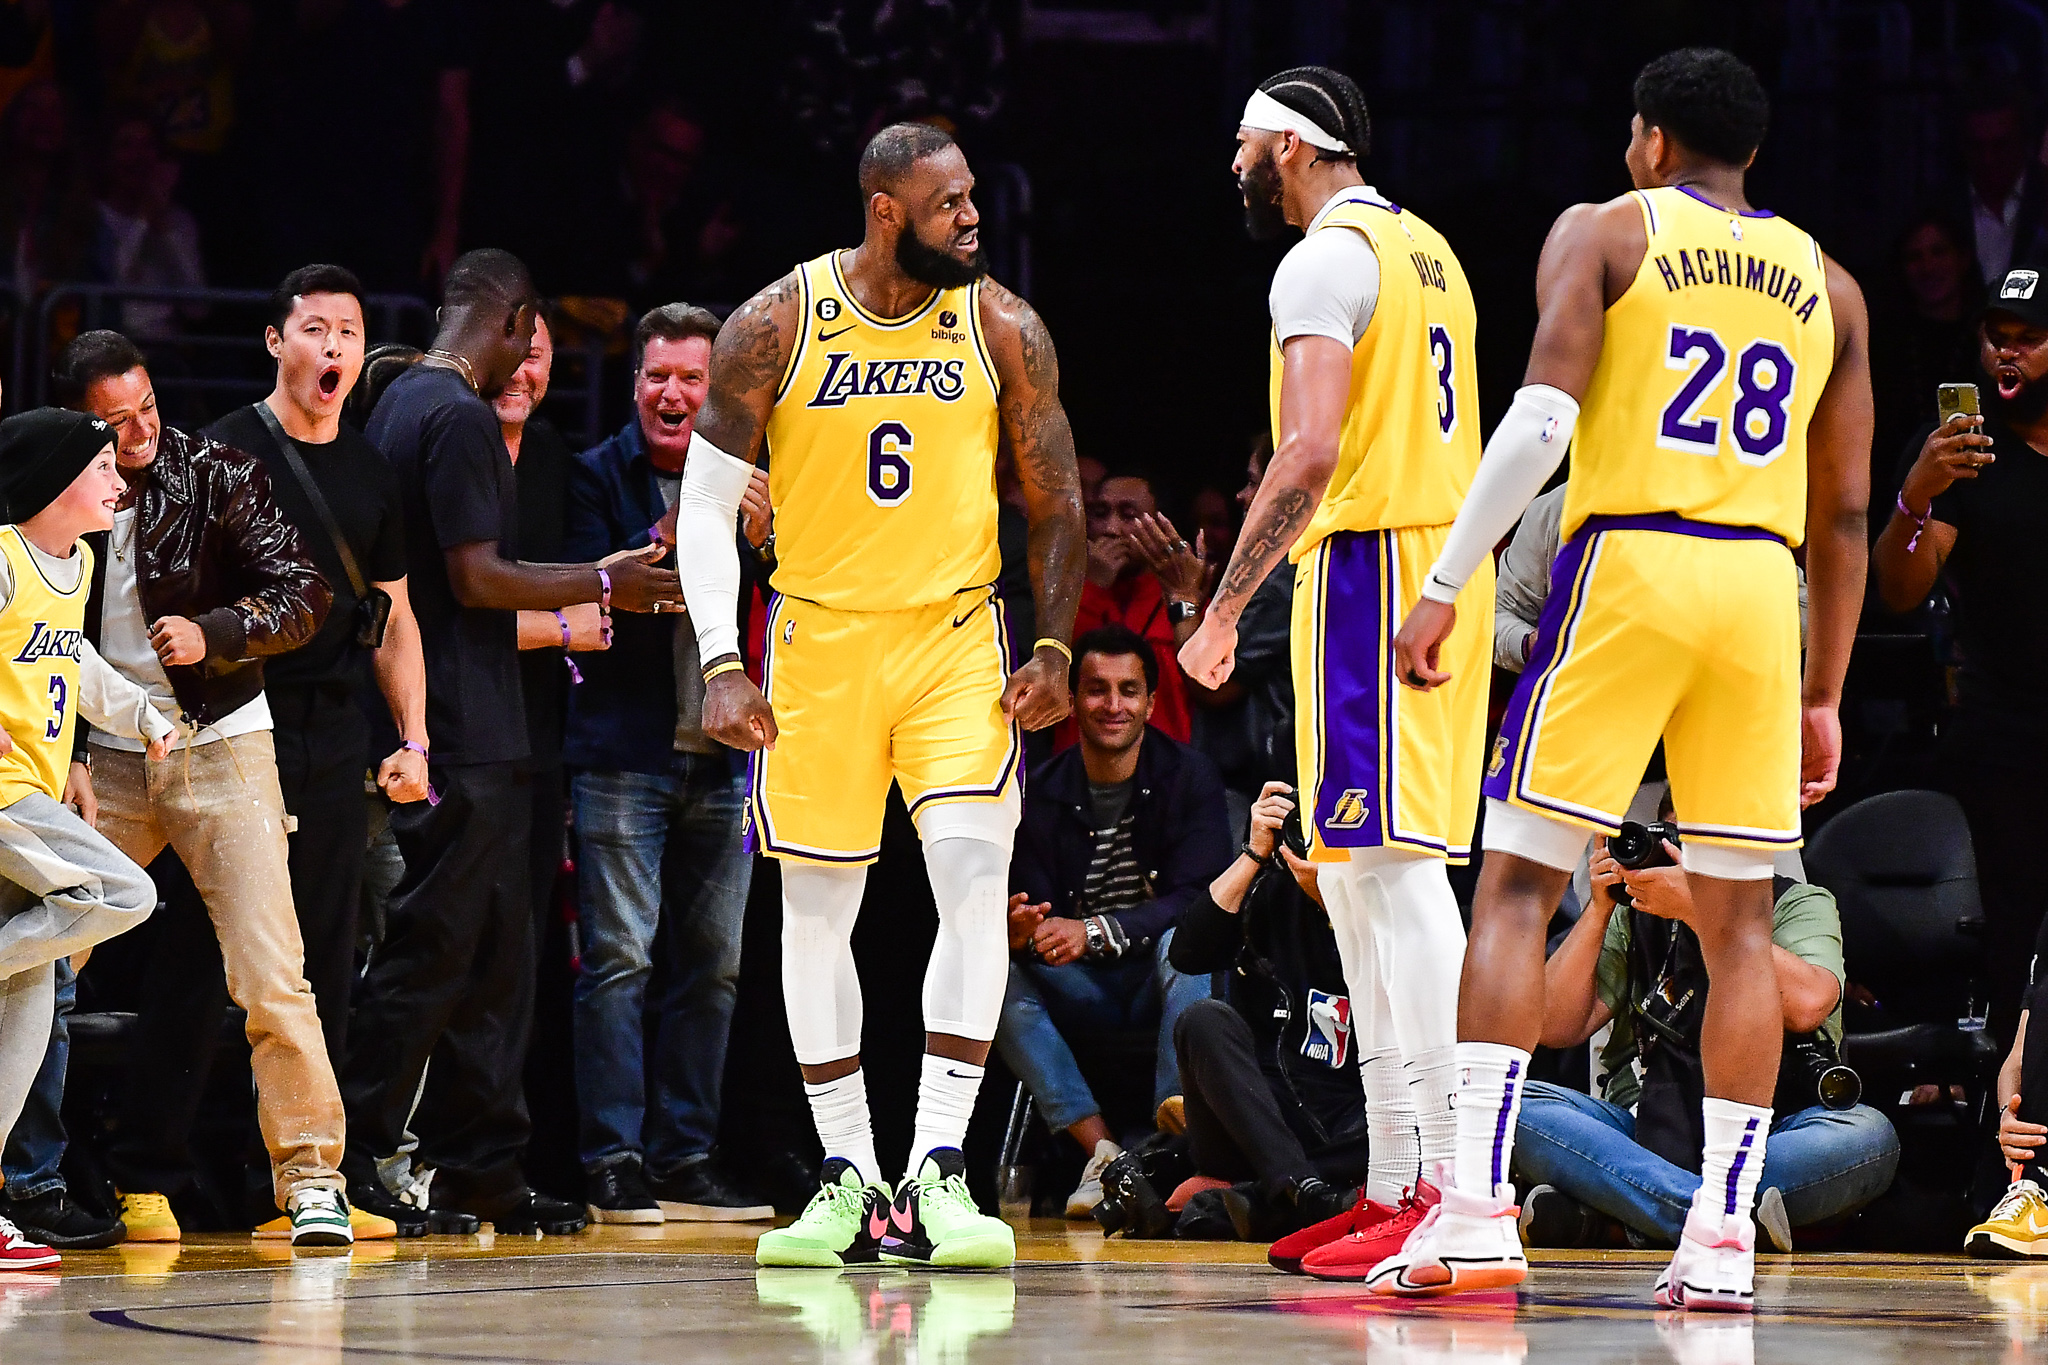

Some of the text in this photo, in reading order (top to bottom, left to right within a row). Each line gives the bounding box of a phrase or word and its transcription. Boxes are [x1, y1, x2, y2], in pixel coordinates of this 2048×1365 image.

[821, 300, 836, 319] 6
[1655, 248, 1819, 324] HACHIMURA
[931, 329, 966, 343] bibigo
[806, 352, 966, 408] LAKERS
[1429, 325, 1457, 438] 3
[1657, 325, 1797, 465] 28
[866, 421, 914, 506] 6
[45, 675, 66, 739] 3
[1306, 1043, 1330, 1061] NBA
